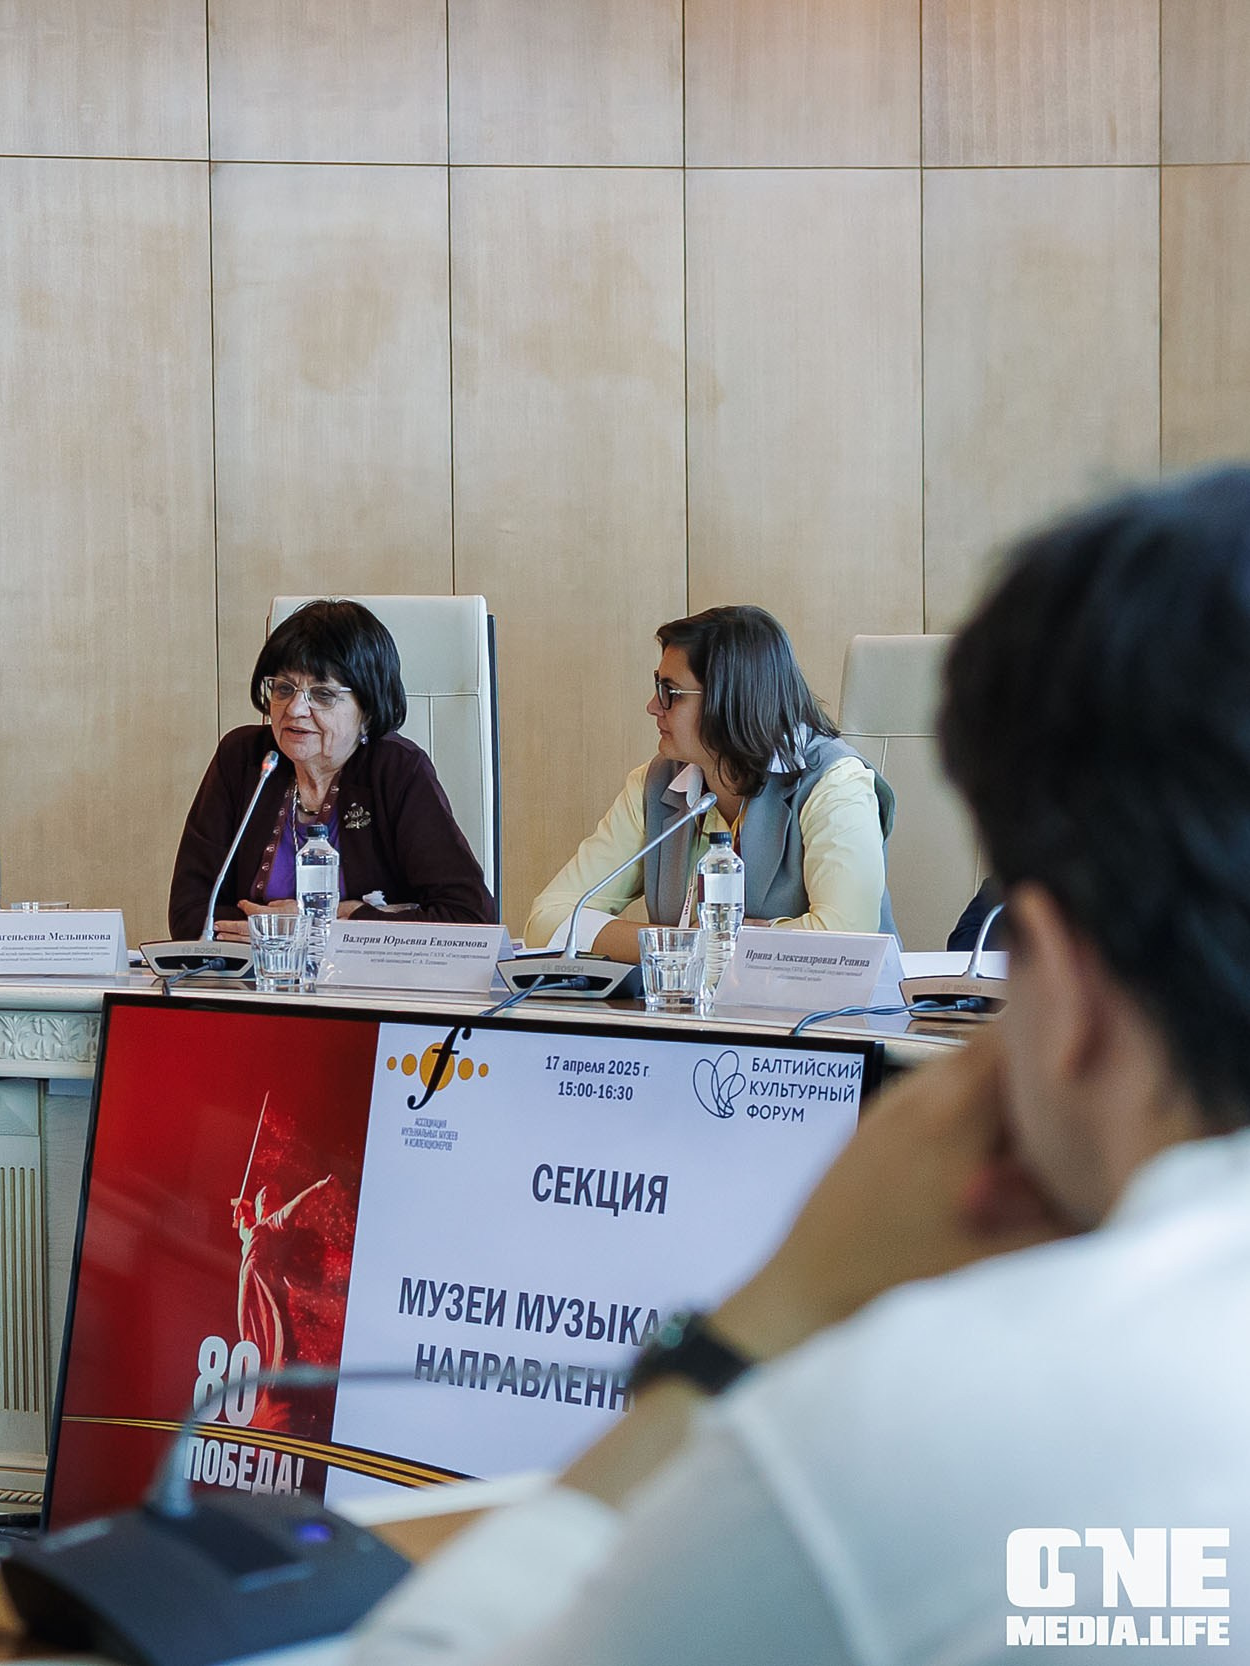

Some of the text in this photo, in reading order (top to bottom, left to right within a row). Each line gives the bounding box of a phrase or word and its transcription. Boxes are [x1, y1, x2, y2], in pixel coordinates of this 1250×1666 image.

[48, 931, 111, 942] Мельникова
[342, 933, 488, 948] Валерия Юрьевна Евдокимова
[745, 949, 870, 967] Ирина Александровна Репина
[545, 1055, 560, 1071] 17
[562, 1059, 605, 1075] апреля
[607, 1059, 641, 1077] 2025
[751, 1057, 862, 1080] БАЛТИЙСКИЙ
[558, 1081, 633, 1101] 15:00-16:30
[749, 1080, 855, 1103] КУЛЬТУРНЫЙ
[746, 1103, 805, 1122] ФОРУМ
[532, 1163, 669, 1217] СЕКЦИЯ
[398, 1277, 661, 1347] МУЗЕИ МУЗЫКА
[193, 1335, 261, 1427] 80
[414, 1343, 631, 1412] НАПРАВЛЕНН
[184, 1436, 305, 1497] ПОБЕДА!
